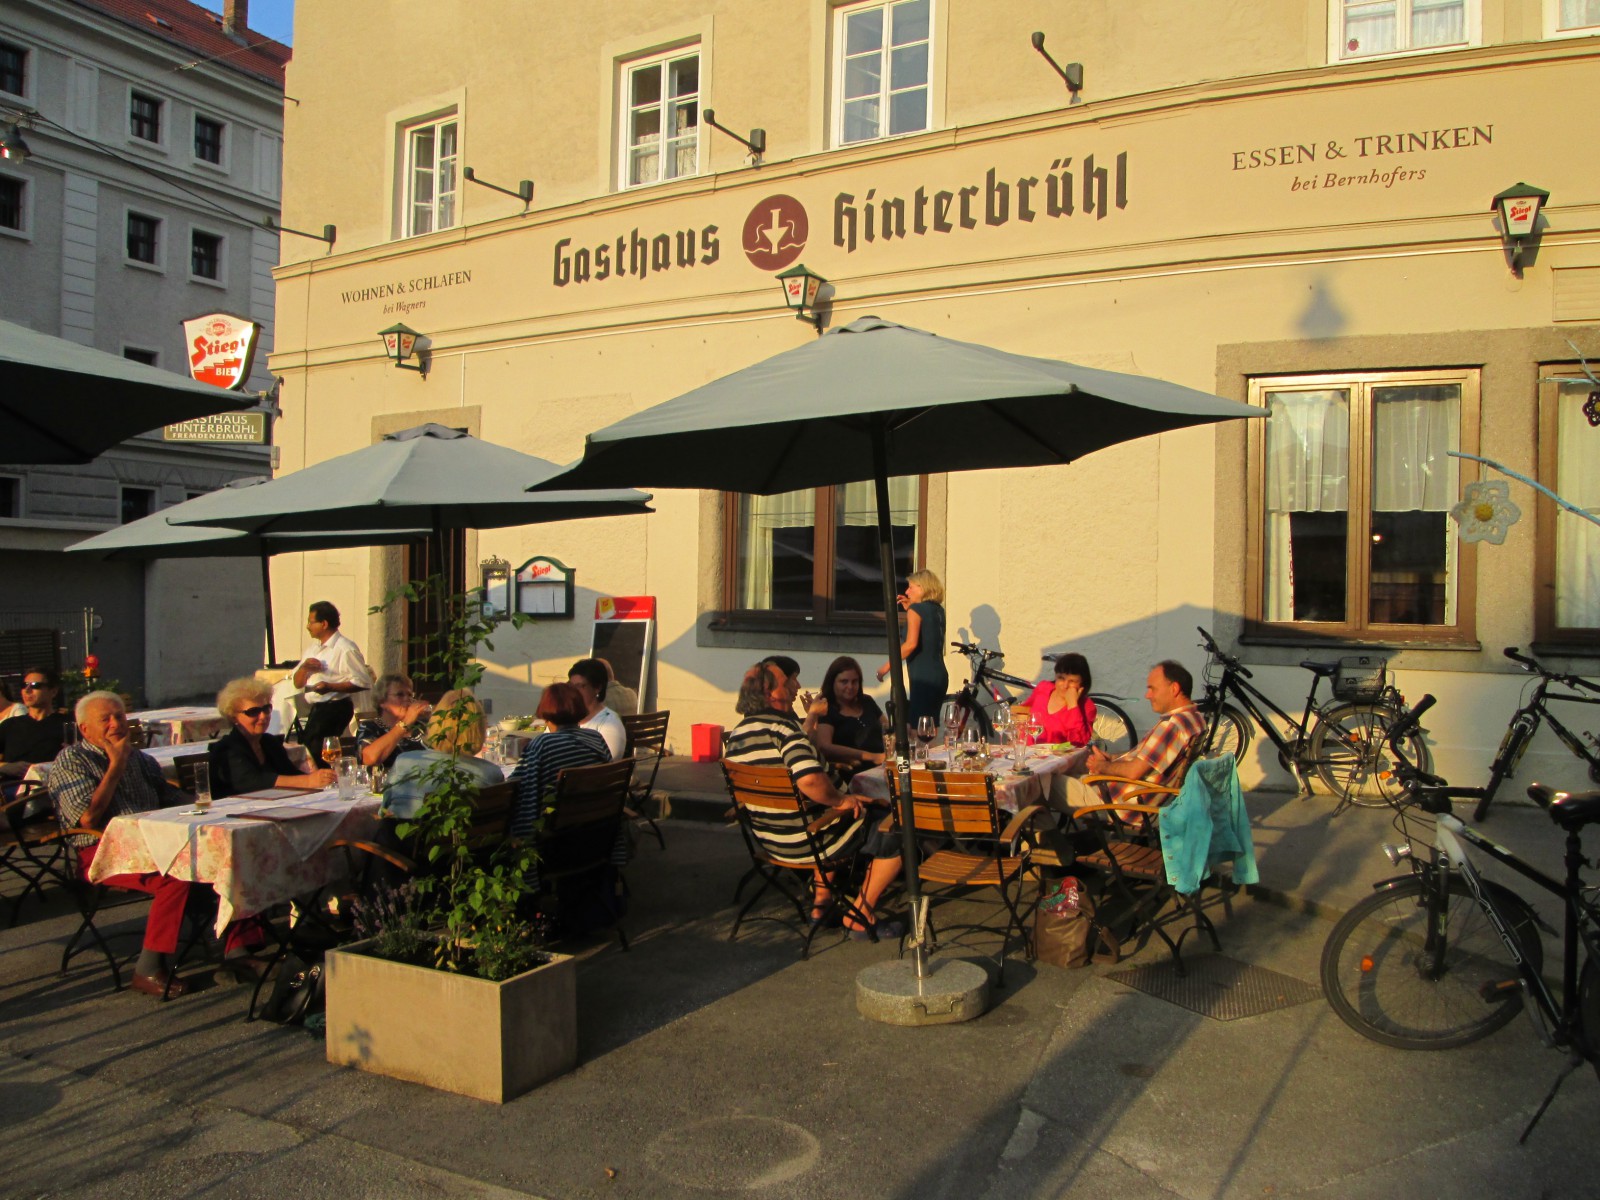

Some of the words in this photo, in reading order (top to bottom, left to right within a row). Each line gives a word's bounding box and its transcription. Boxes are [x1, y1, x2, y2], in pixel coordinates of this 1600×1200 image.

[1232, 143, 1316, 170] ESSEN
[1325, 141, 1347, 160] &
[1354, 124, 1494, 158] TRINKEN
[1290, 175, 1317, 191] bei
[1323, 166, 1427, 189] Bernhofers
[553, 223, 720, 288] Gasthaus
[833, 151, 1128, 254] Hinterbrühl
[341, 283, 395, 305] WOHNEN
[396, 282, 406, 295] &
[408, 270, 472, 293] SCHLAFEN
[383, 304, 394, 314] bei
[396, 300, 427, 315] Wagners
[169, 423, 258, 434] HINTERBRÜHL
[172, 432, 255, 440] FREMDENZIMMER
